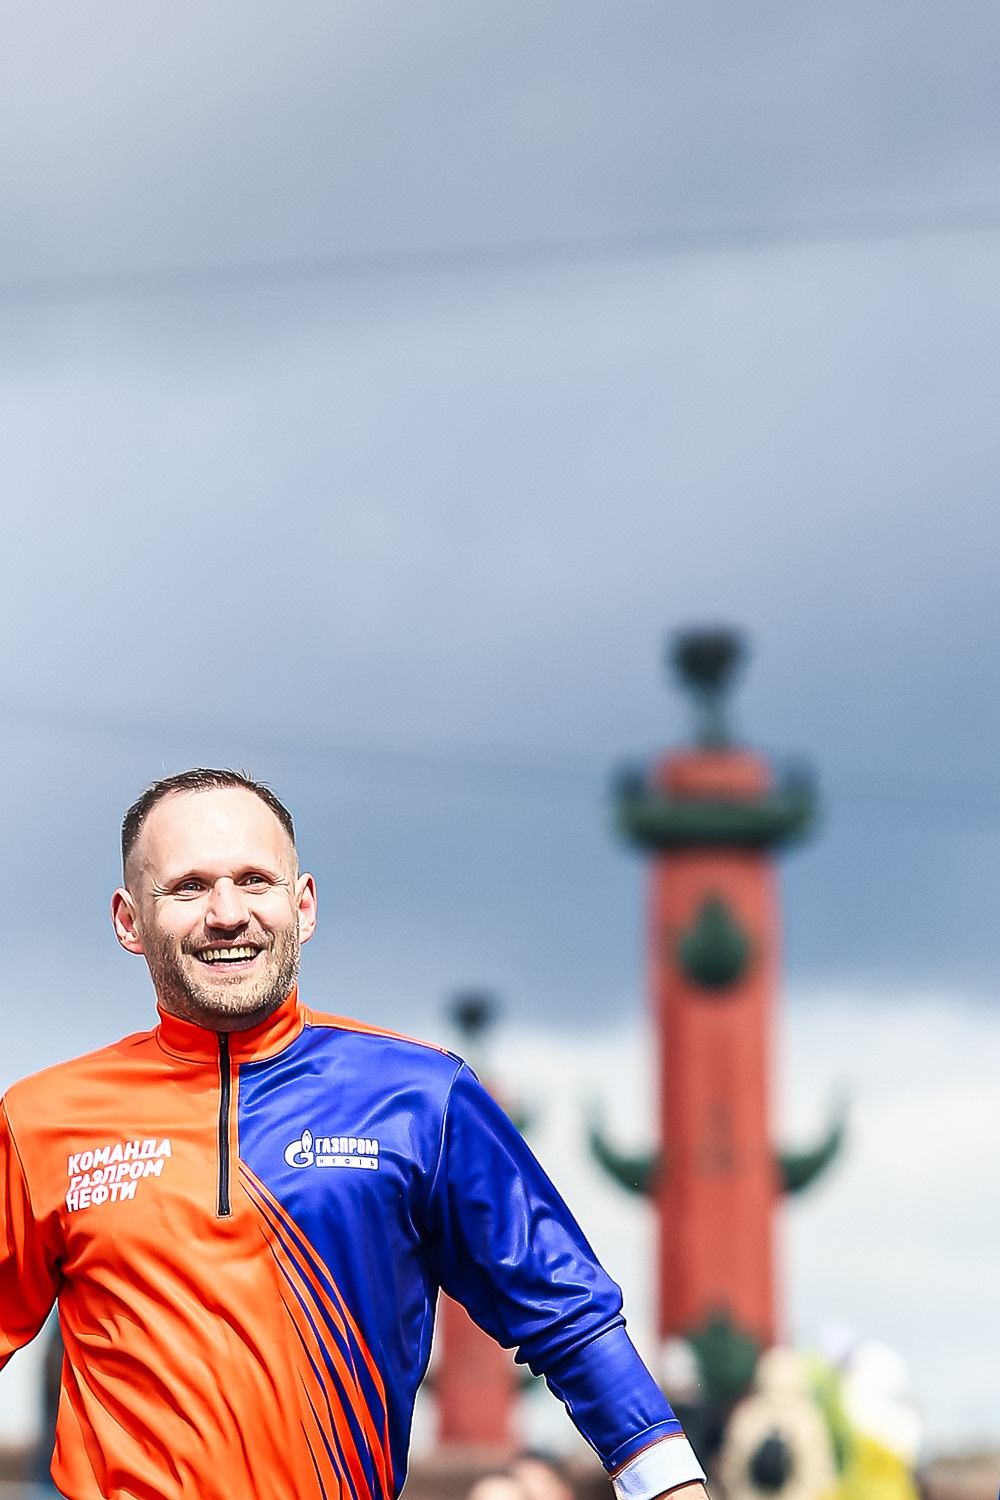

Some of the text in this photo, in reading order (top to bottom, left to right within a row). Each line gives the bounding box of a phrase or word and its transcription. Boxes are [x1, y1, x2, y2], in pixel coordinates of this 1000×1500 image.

[68, 1138, 172, 1176] КОМАНДА
[315, 1136, 379, 1156] ГАЗПРОМ
[67, 1158, 164, 1193] ГАЗПРОМ
[65, 1180, 138, 1213] НЕФТИ
